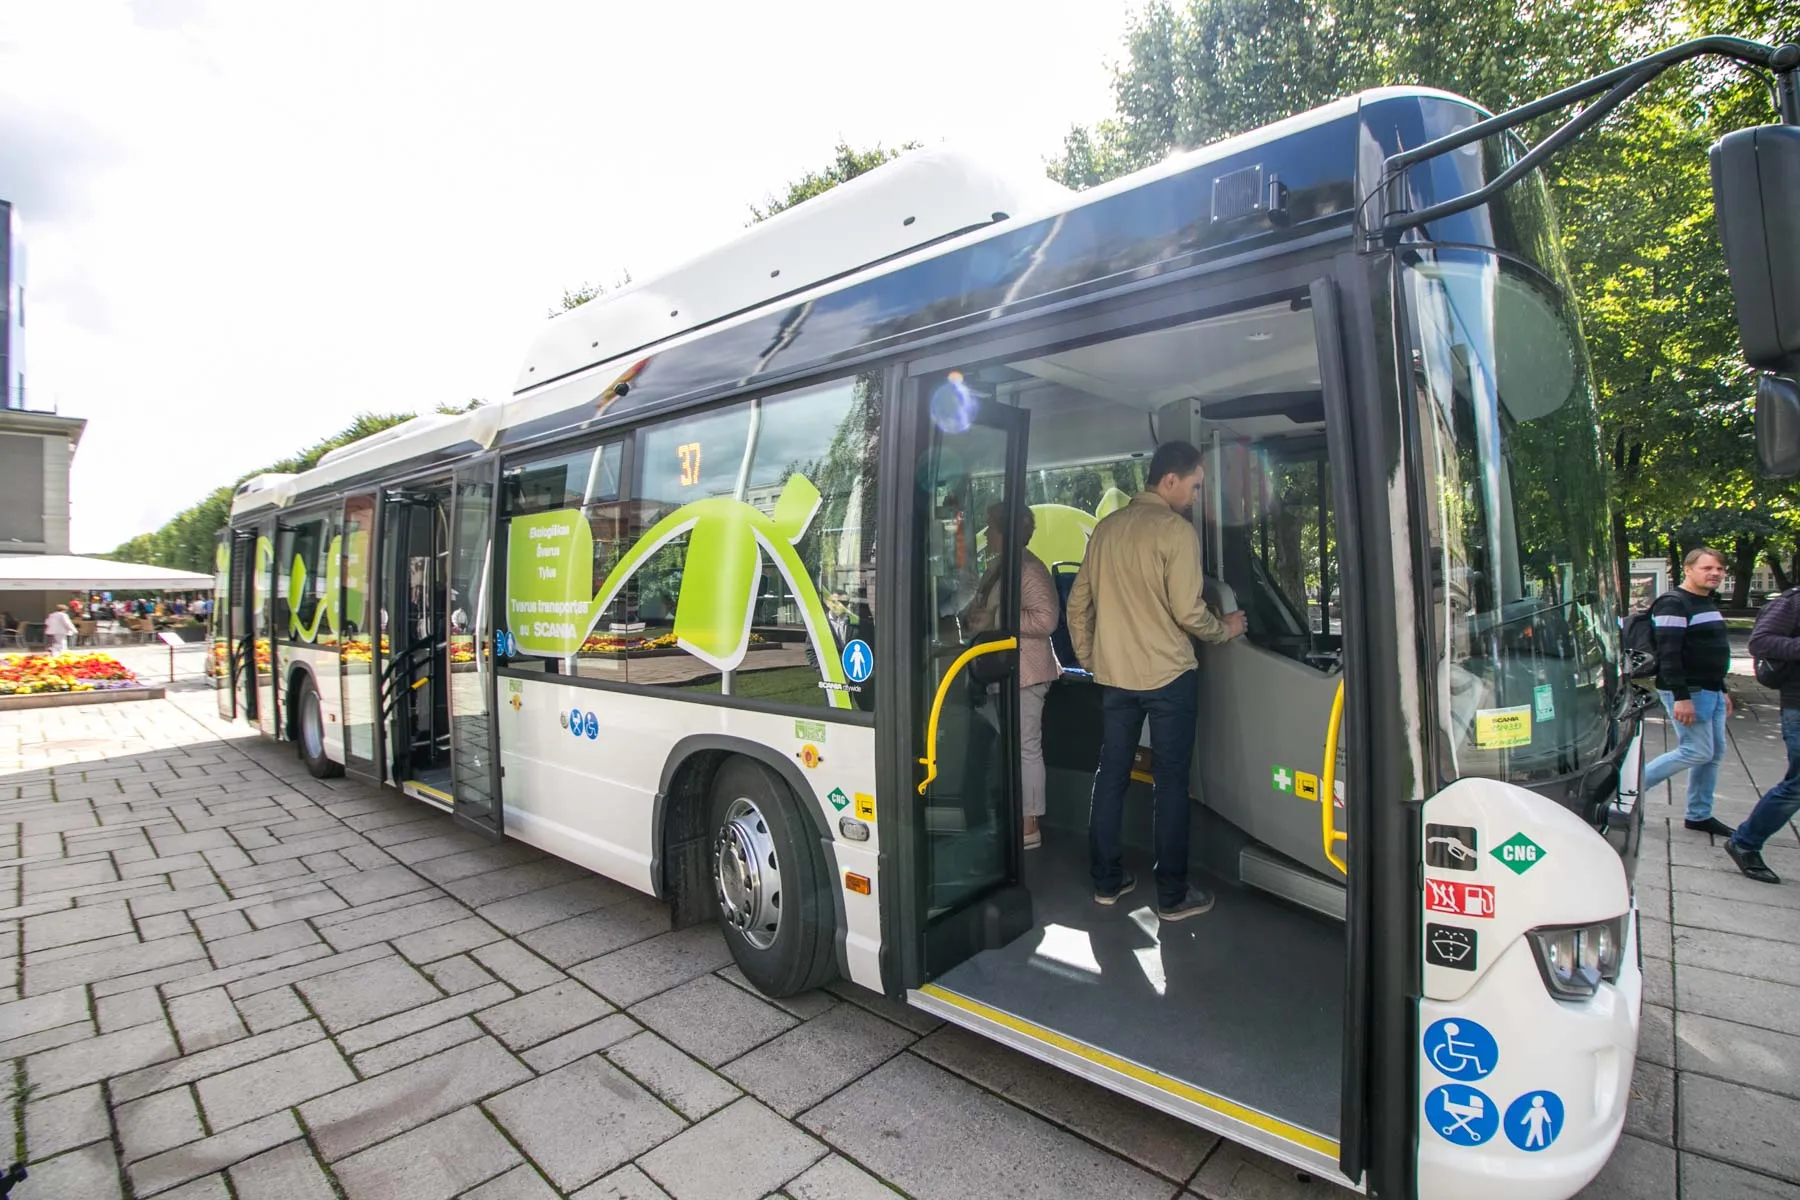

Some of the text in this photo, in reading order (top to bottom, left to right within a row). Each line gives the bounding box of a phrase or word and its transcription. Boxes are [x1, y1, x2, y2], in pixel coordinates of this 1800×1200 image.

[677, 442, 701, 487] 37
[533, 621, 577, 640] SCANIA
[831, 792, 846, 806] CNG
[1503, 844, 1537, 862] CNG
